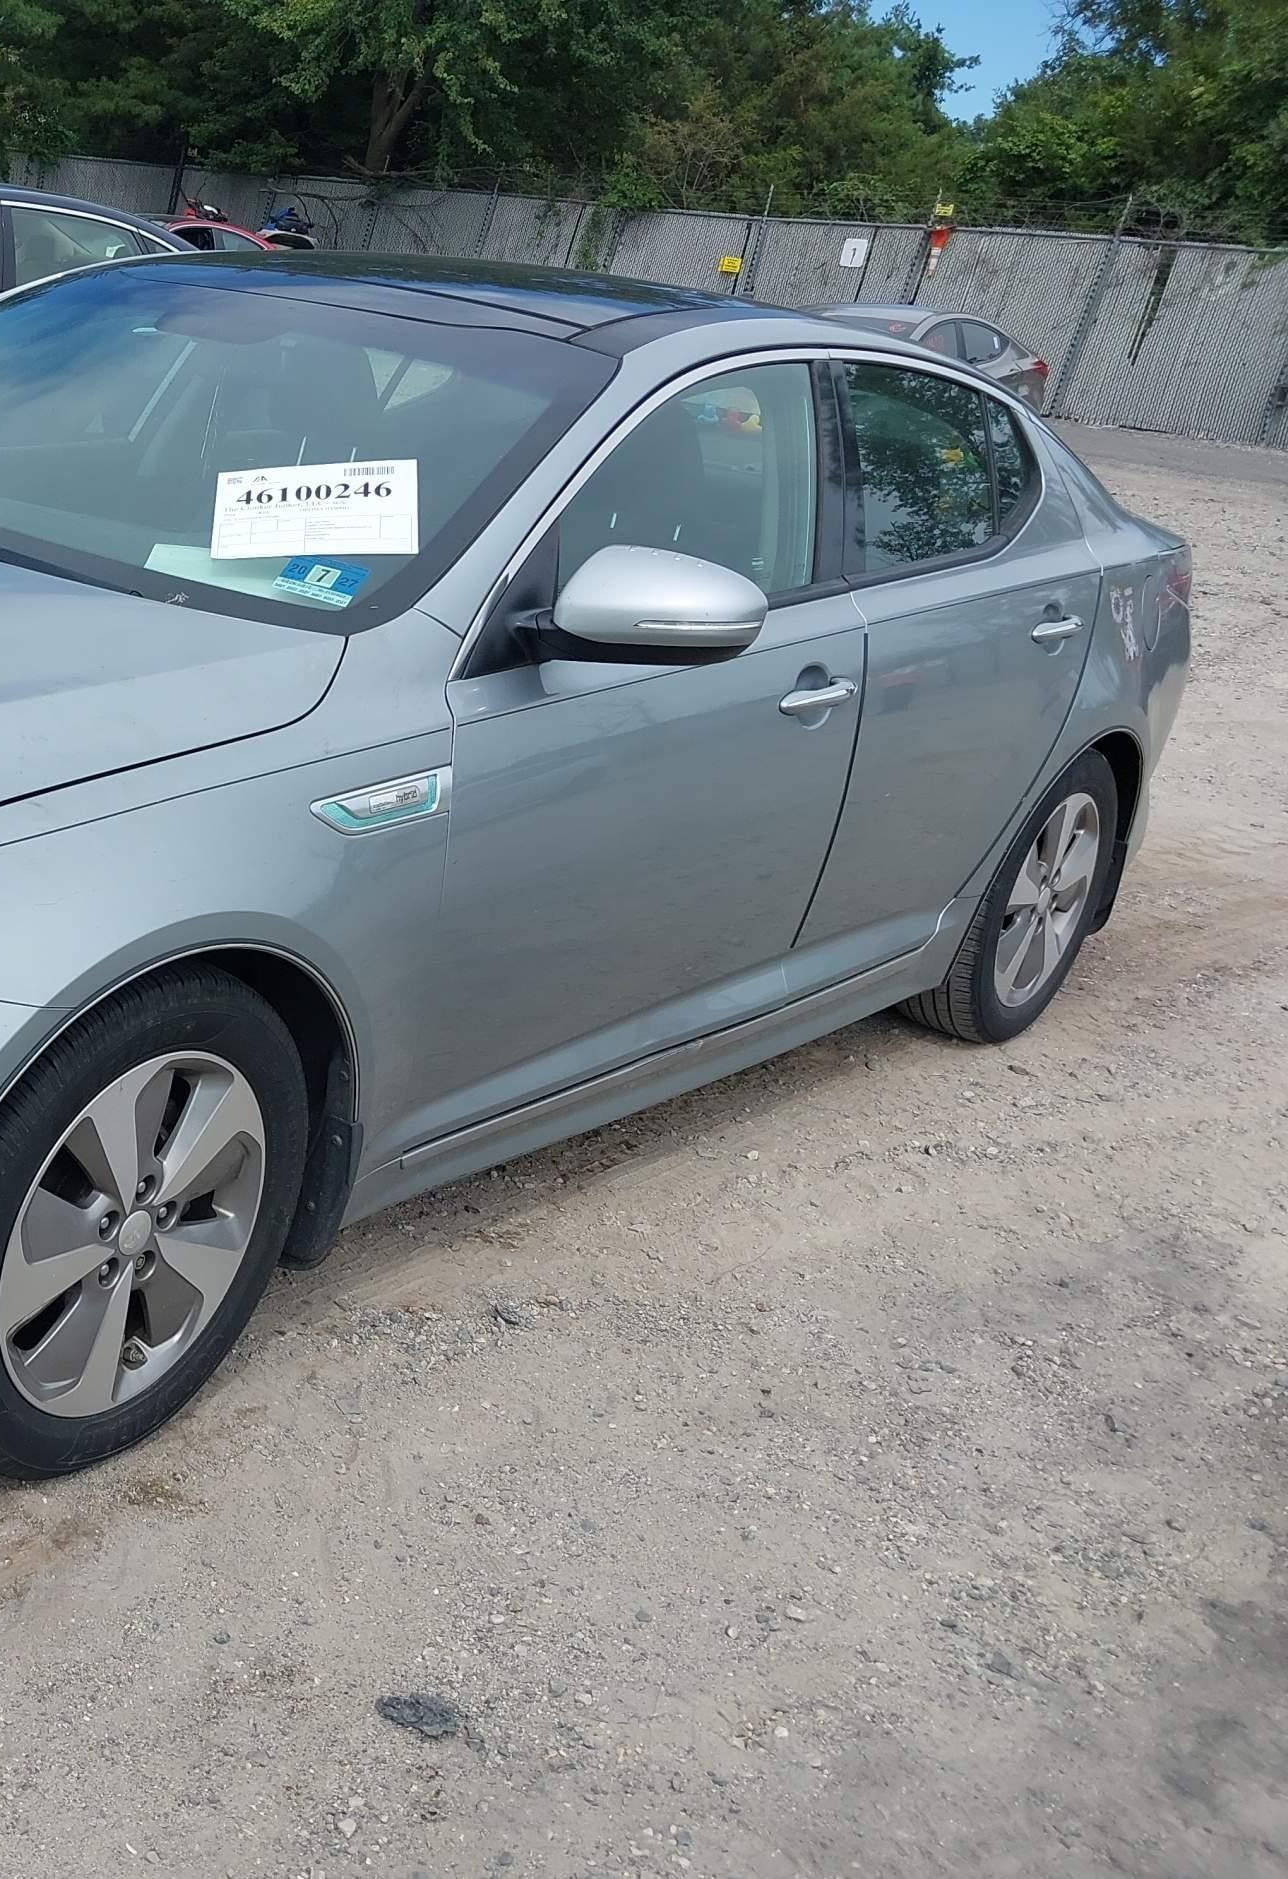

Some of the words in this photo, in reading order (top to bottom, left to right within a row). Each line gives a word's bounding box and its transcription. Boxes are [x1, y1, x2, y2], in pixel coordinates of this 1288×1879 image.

[236, 481, 393, 505] 46100246
[289, 563, 308, 575] 20
[316, 569, 331, 583] 7
[339, 578, 359, 588] 27
